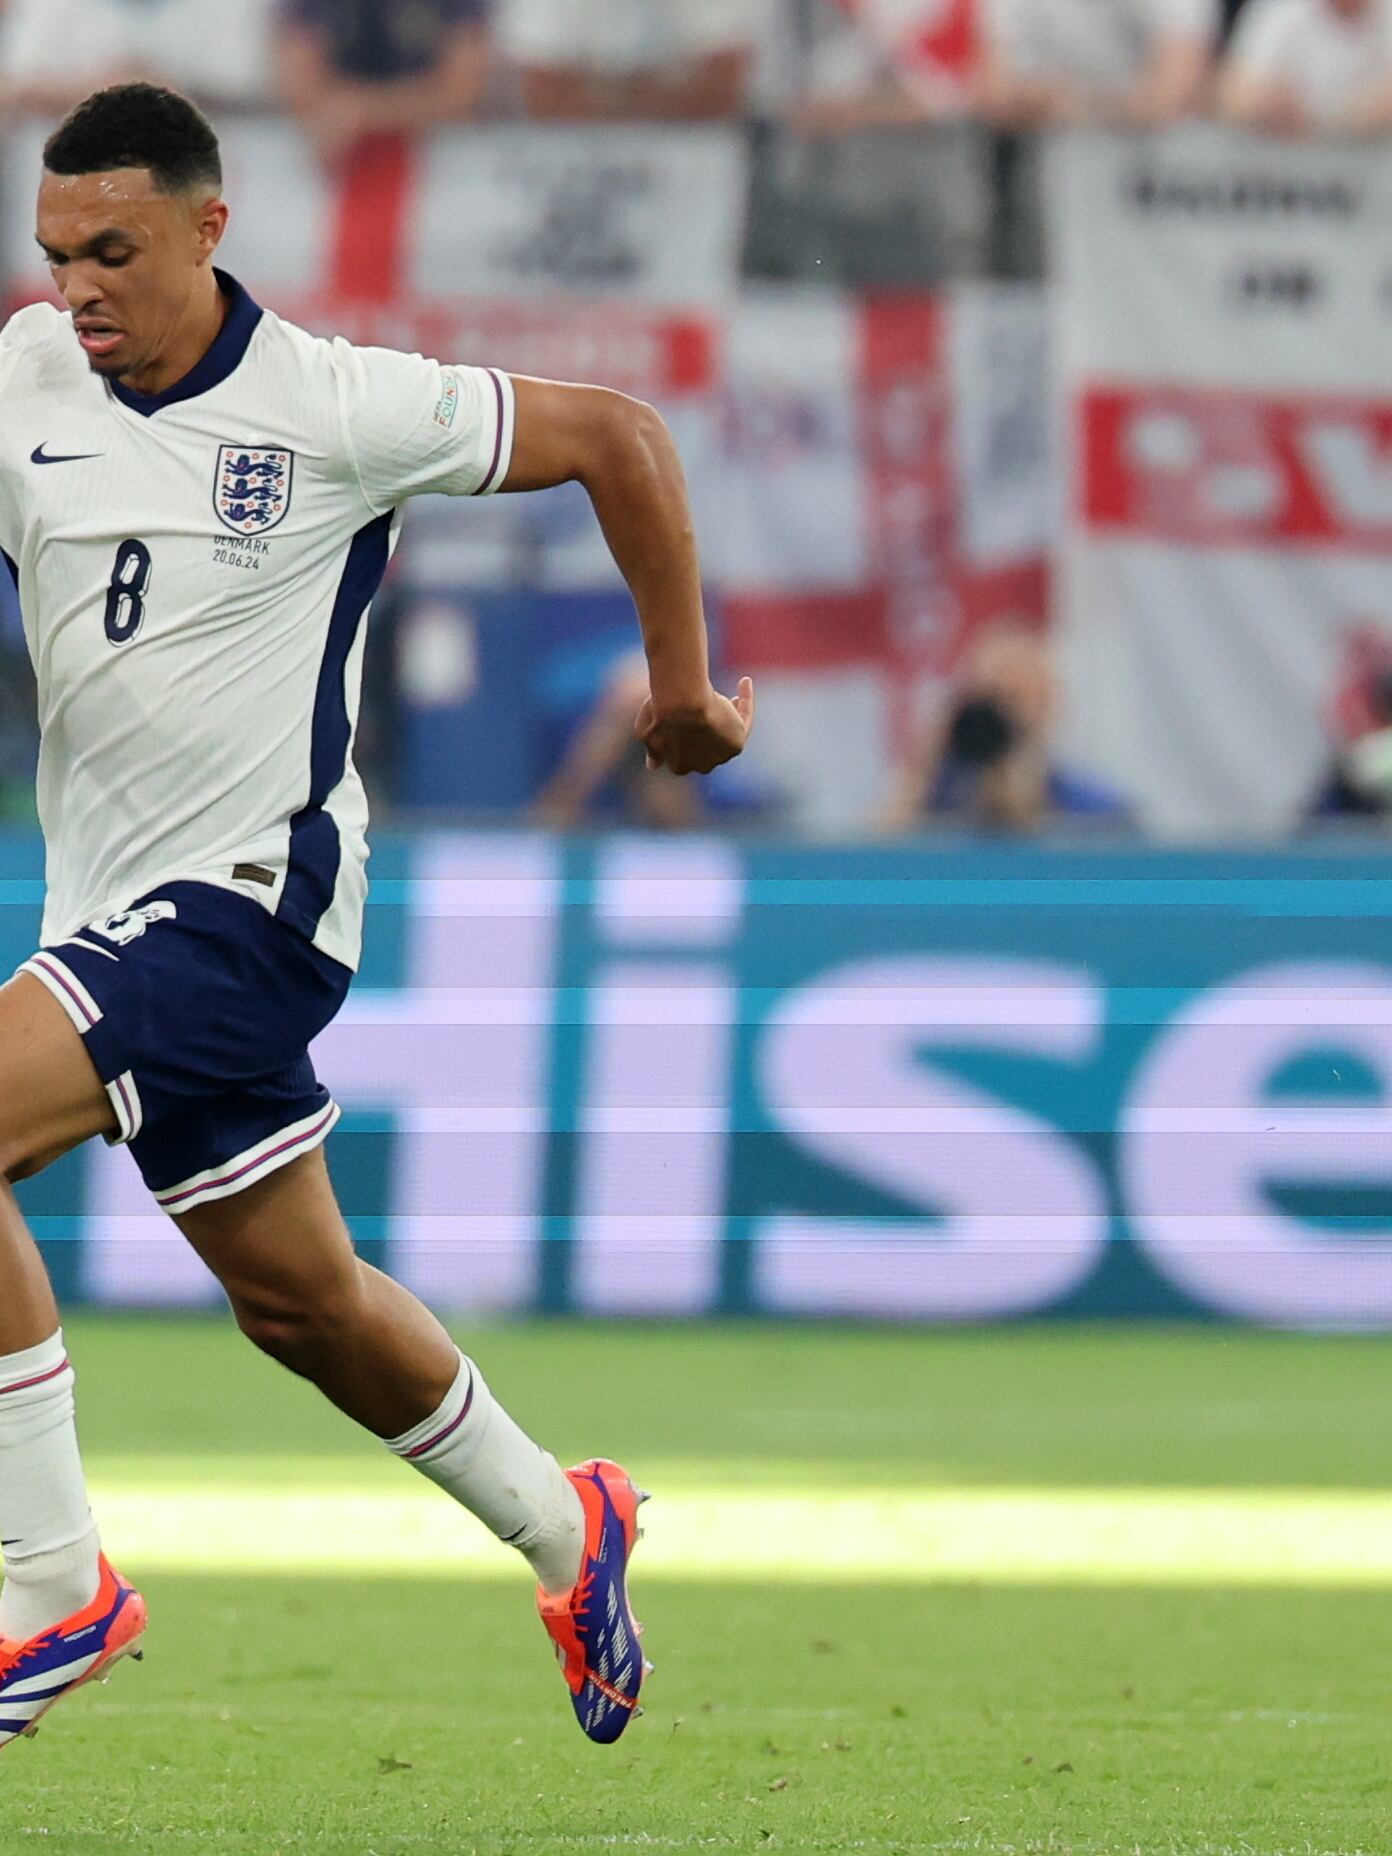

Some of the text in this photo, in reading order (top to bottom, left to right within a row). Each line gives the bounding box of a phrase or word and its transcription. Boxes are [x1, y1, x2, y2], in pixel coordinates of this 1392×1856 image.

[213, 548, 259, 570] 20.06.24
[214, 535, 270, 555] DENMARK
[104, 538, 151, 647] 8
[81, 832, 1392, 1330] Hise
